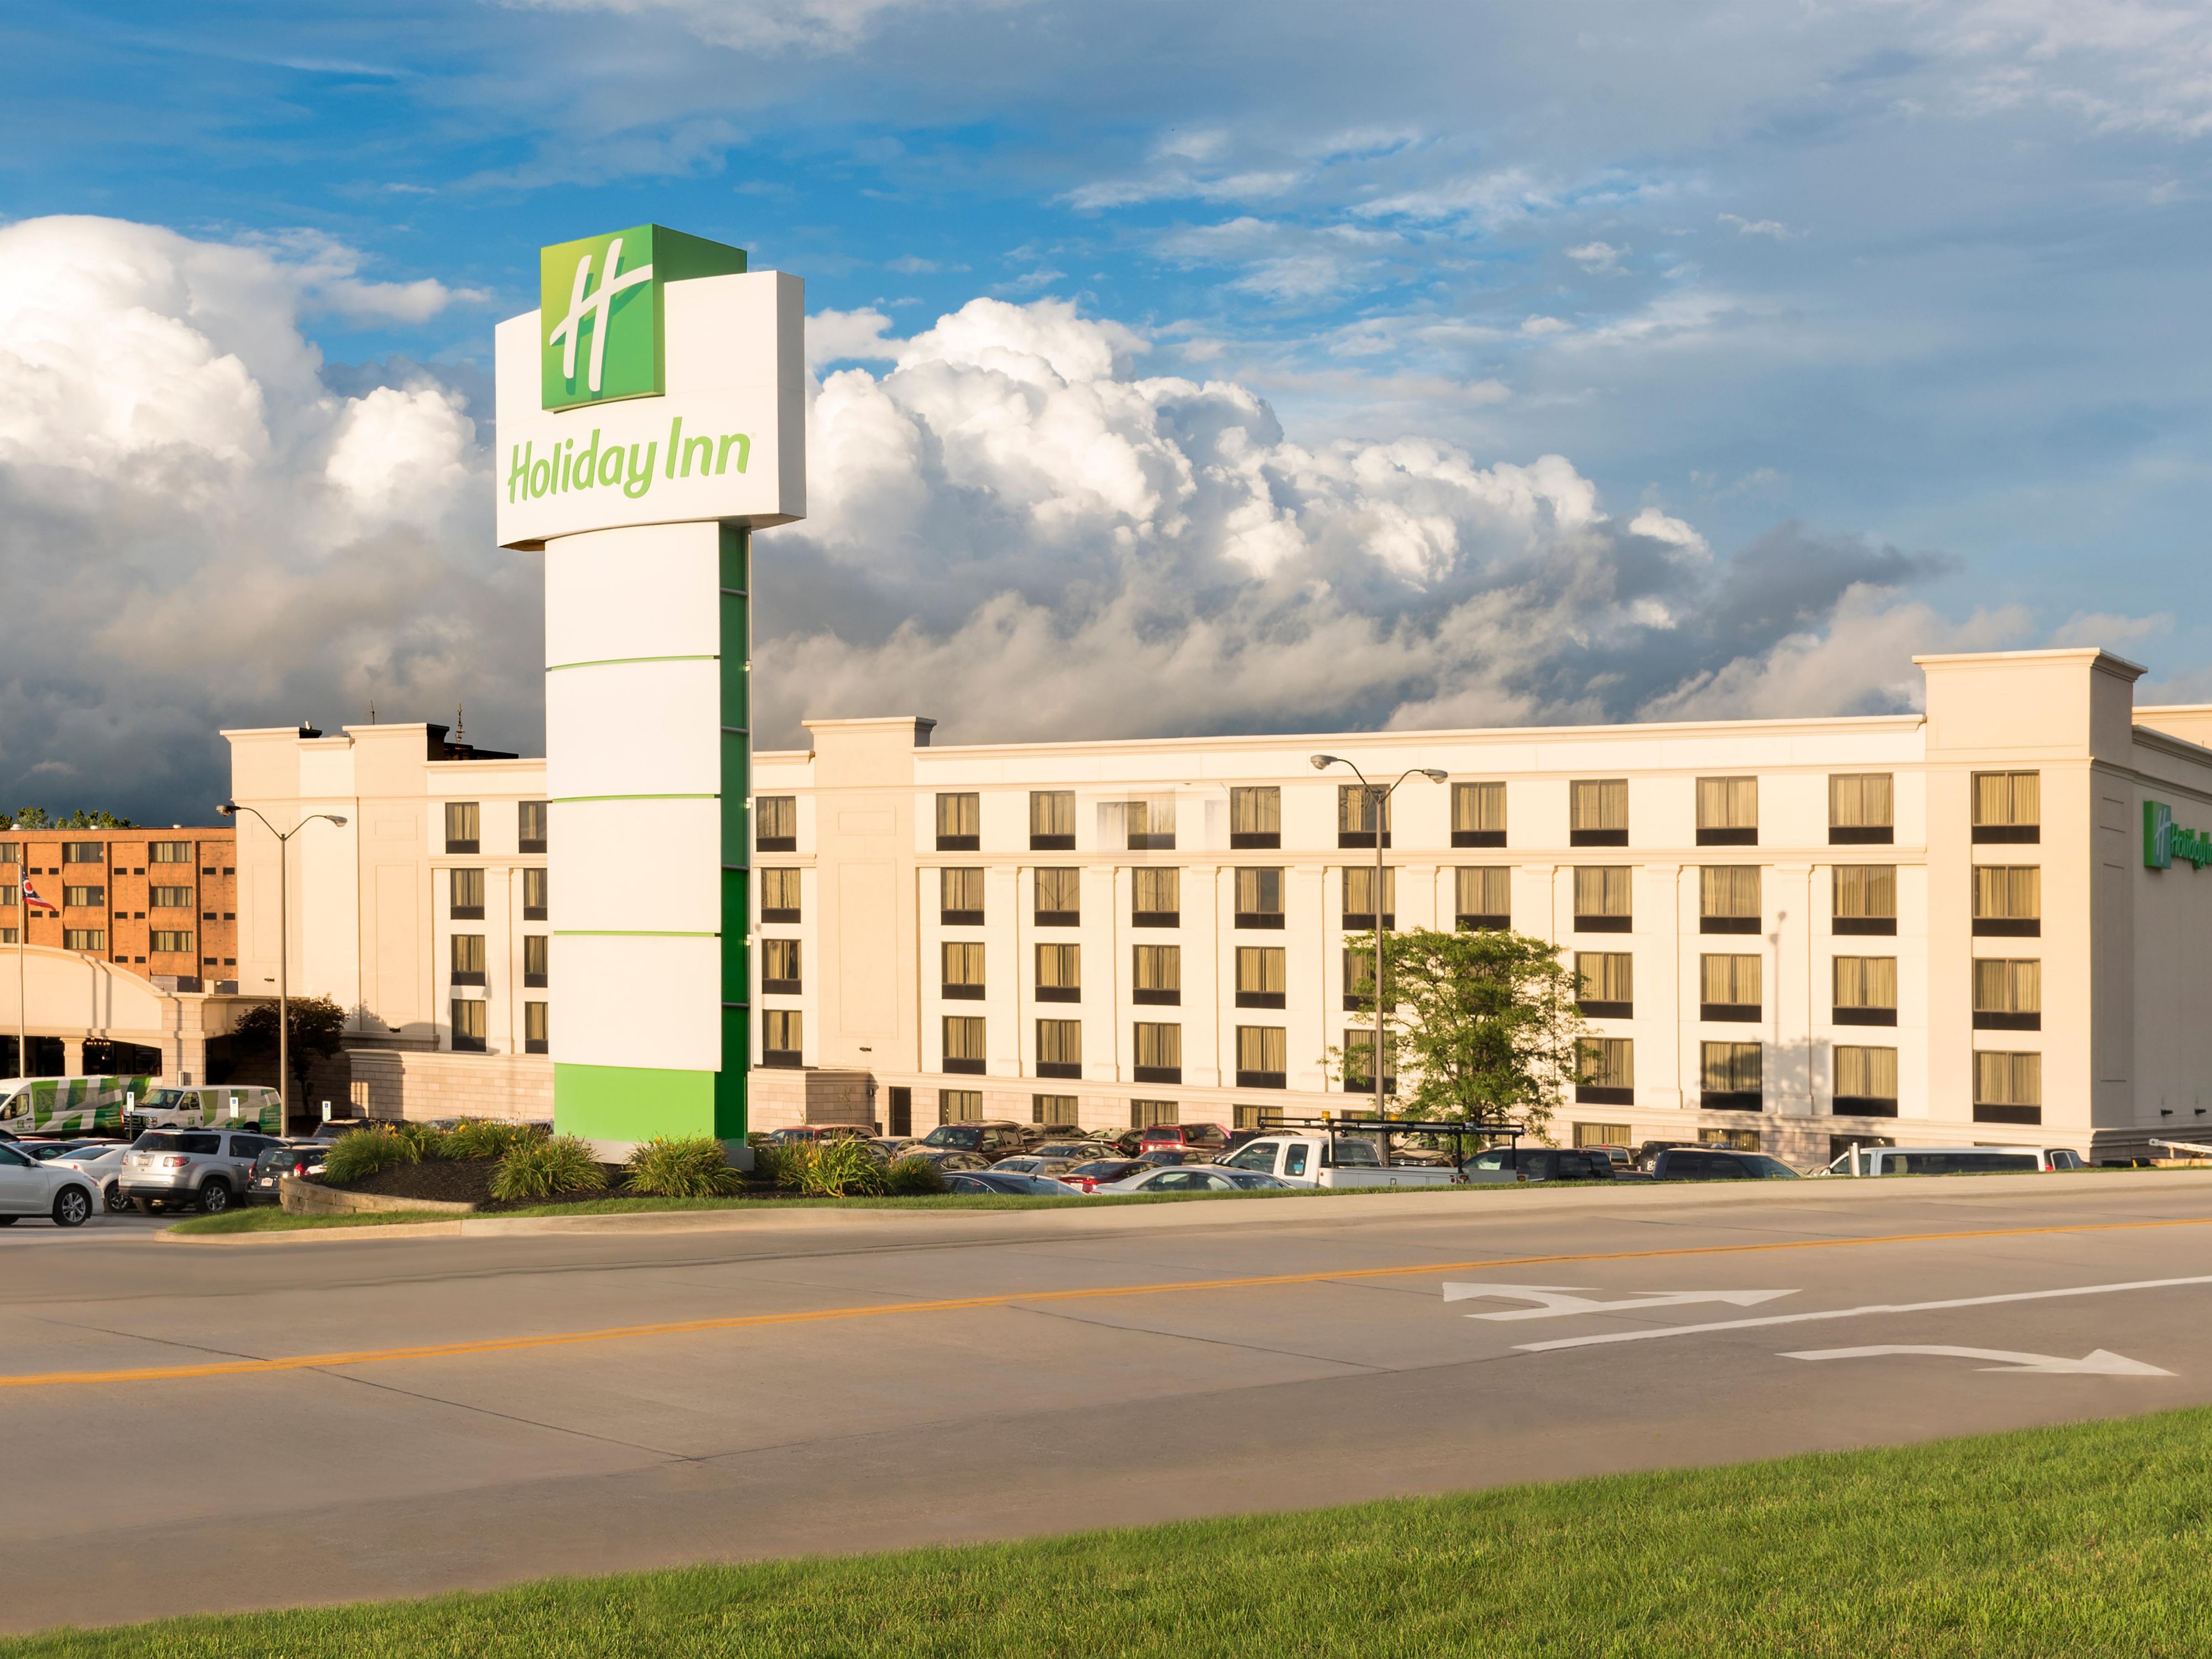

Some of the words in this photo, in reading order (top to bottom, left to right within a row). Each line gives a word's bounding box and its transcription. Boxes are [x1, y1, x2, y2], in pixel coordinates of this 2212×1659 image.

[550, 238, 653, 392] H
[508, 429, 657, 504] Holiday
[665, 416, 750, 479] Inn
